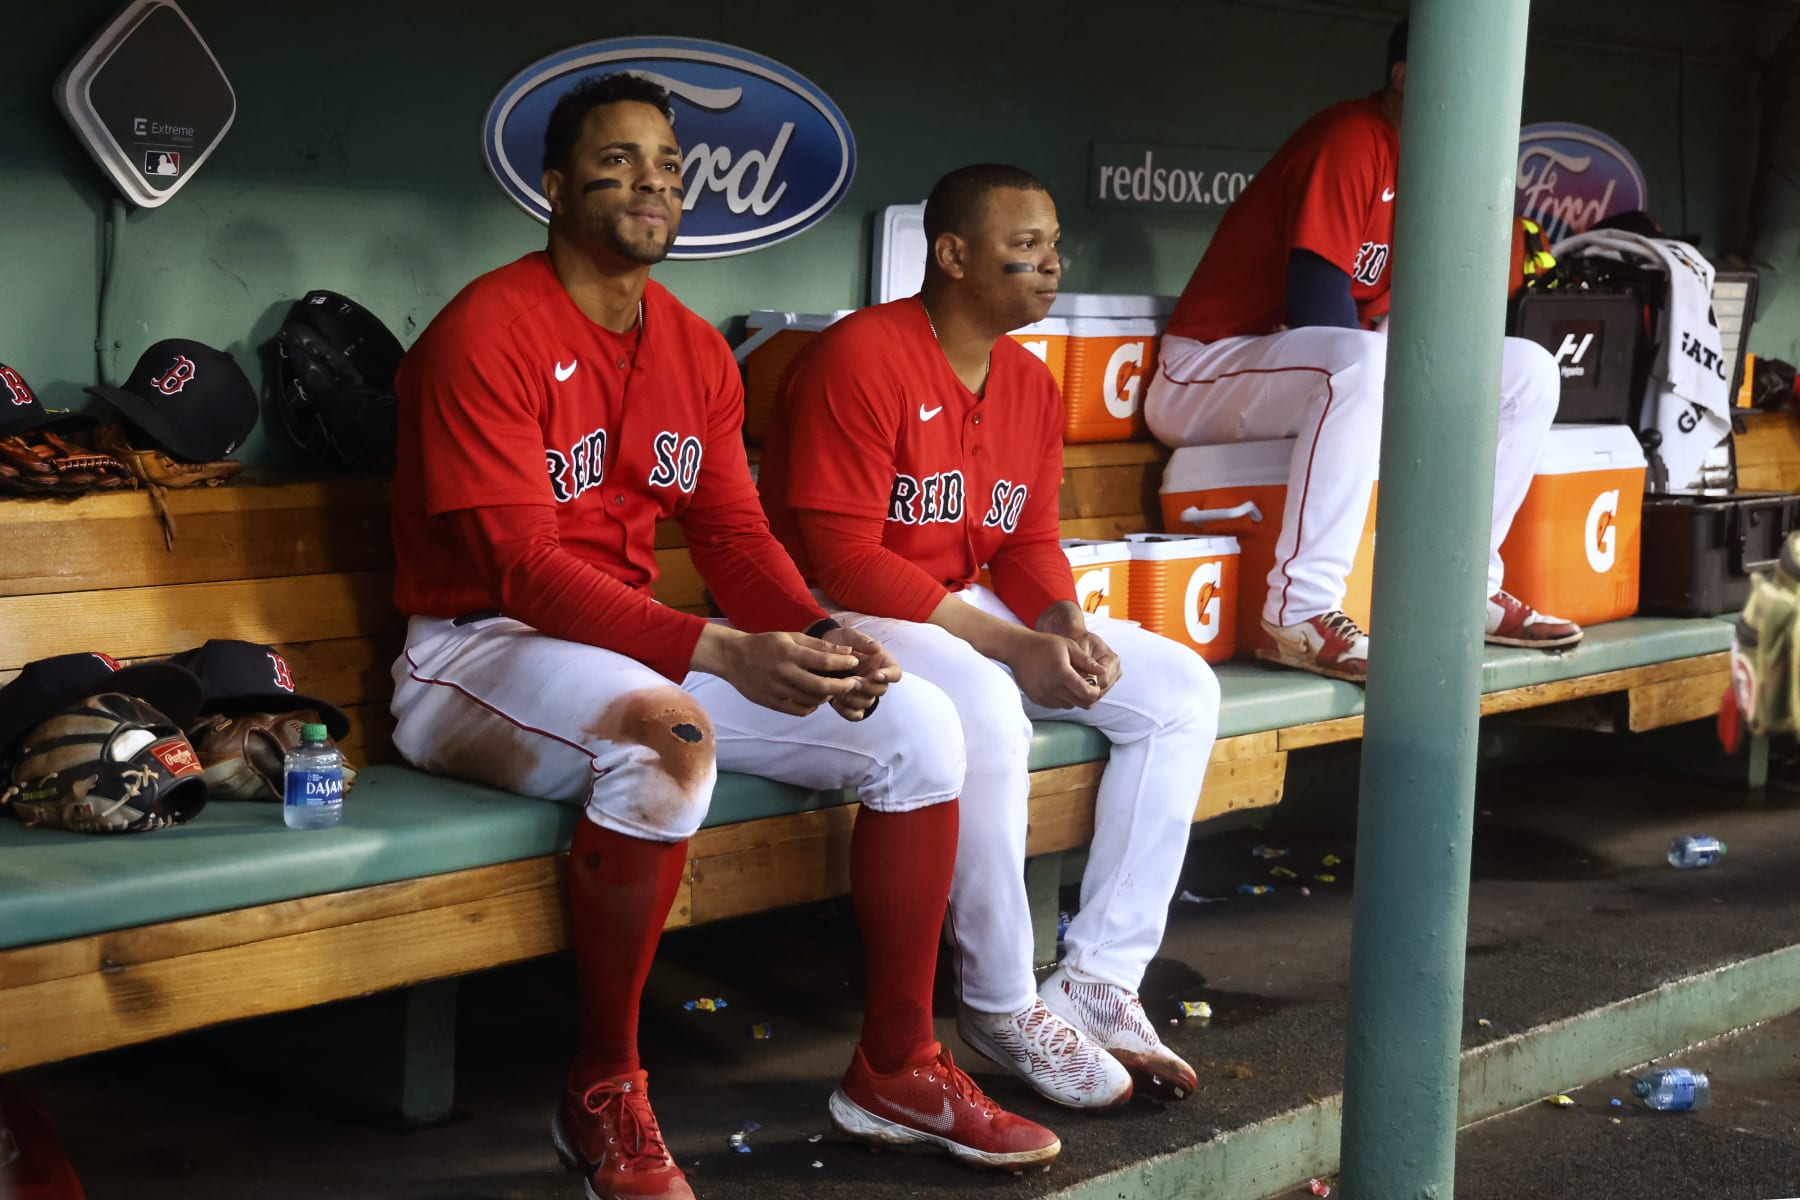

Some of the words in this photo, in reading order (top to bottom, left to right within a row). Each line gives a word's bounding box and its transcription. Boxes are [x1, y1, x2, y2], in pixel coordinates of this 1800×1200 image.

[151, 122, 194, 137] Extreme
[1099, 151, 1255, 204] redsox.co
[150, 354, 196, 395] B
[1103, 341, 1145, 419] G
[545, 428, 607, 503] RED
[649, 431, 703, 494] SO
[887, 469, 966, 526] RED
[982, 479, 1027, 534] SO
[1584, 489, 1620, 574] G
[1184, 561, 1222, 645] G
